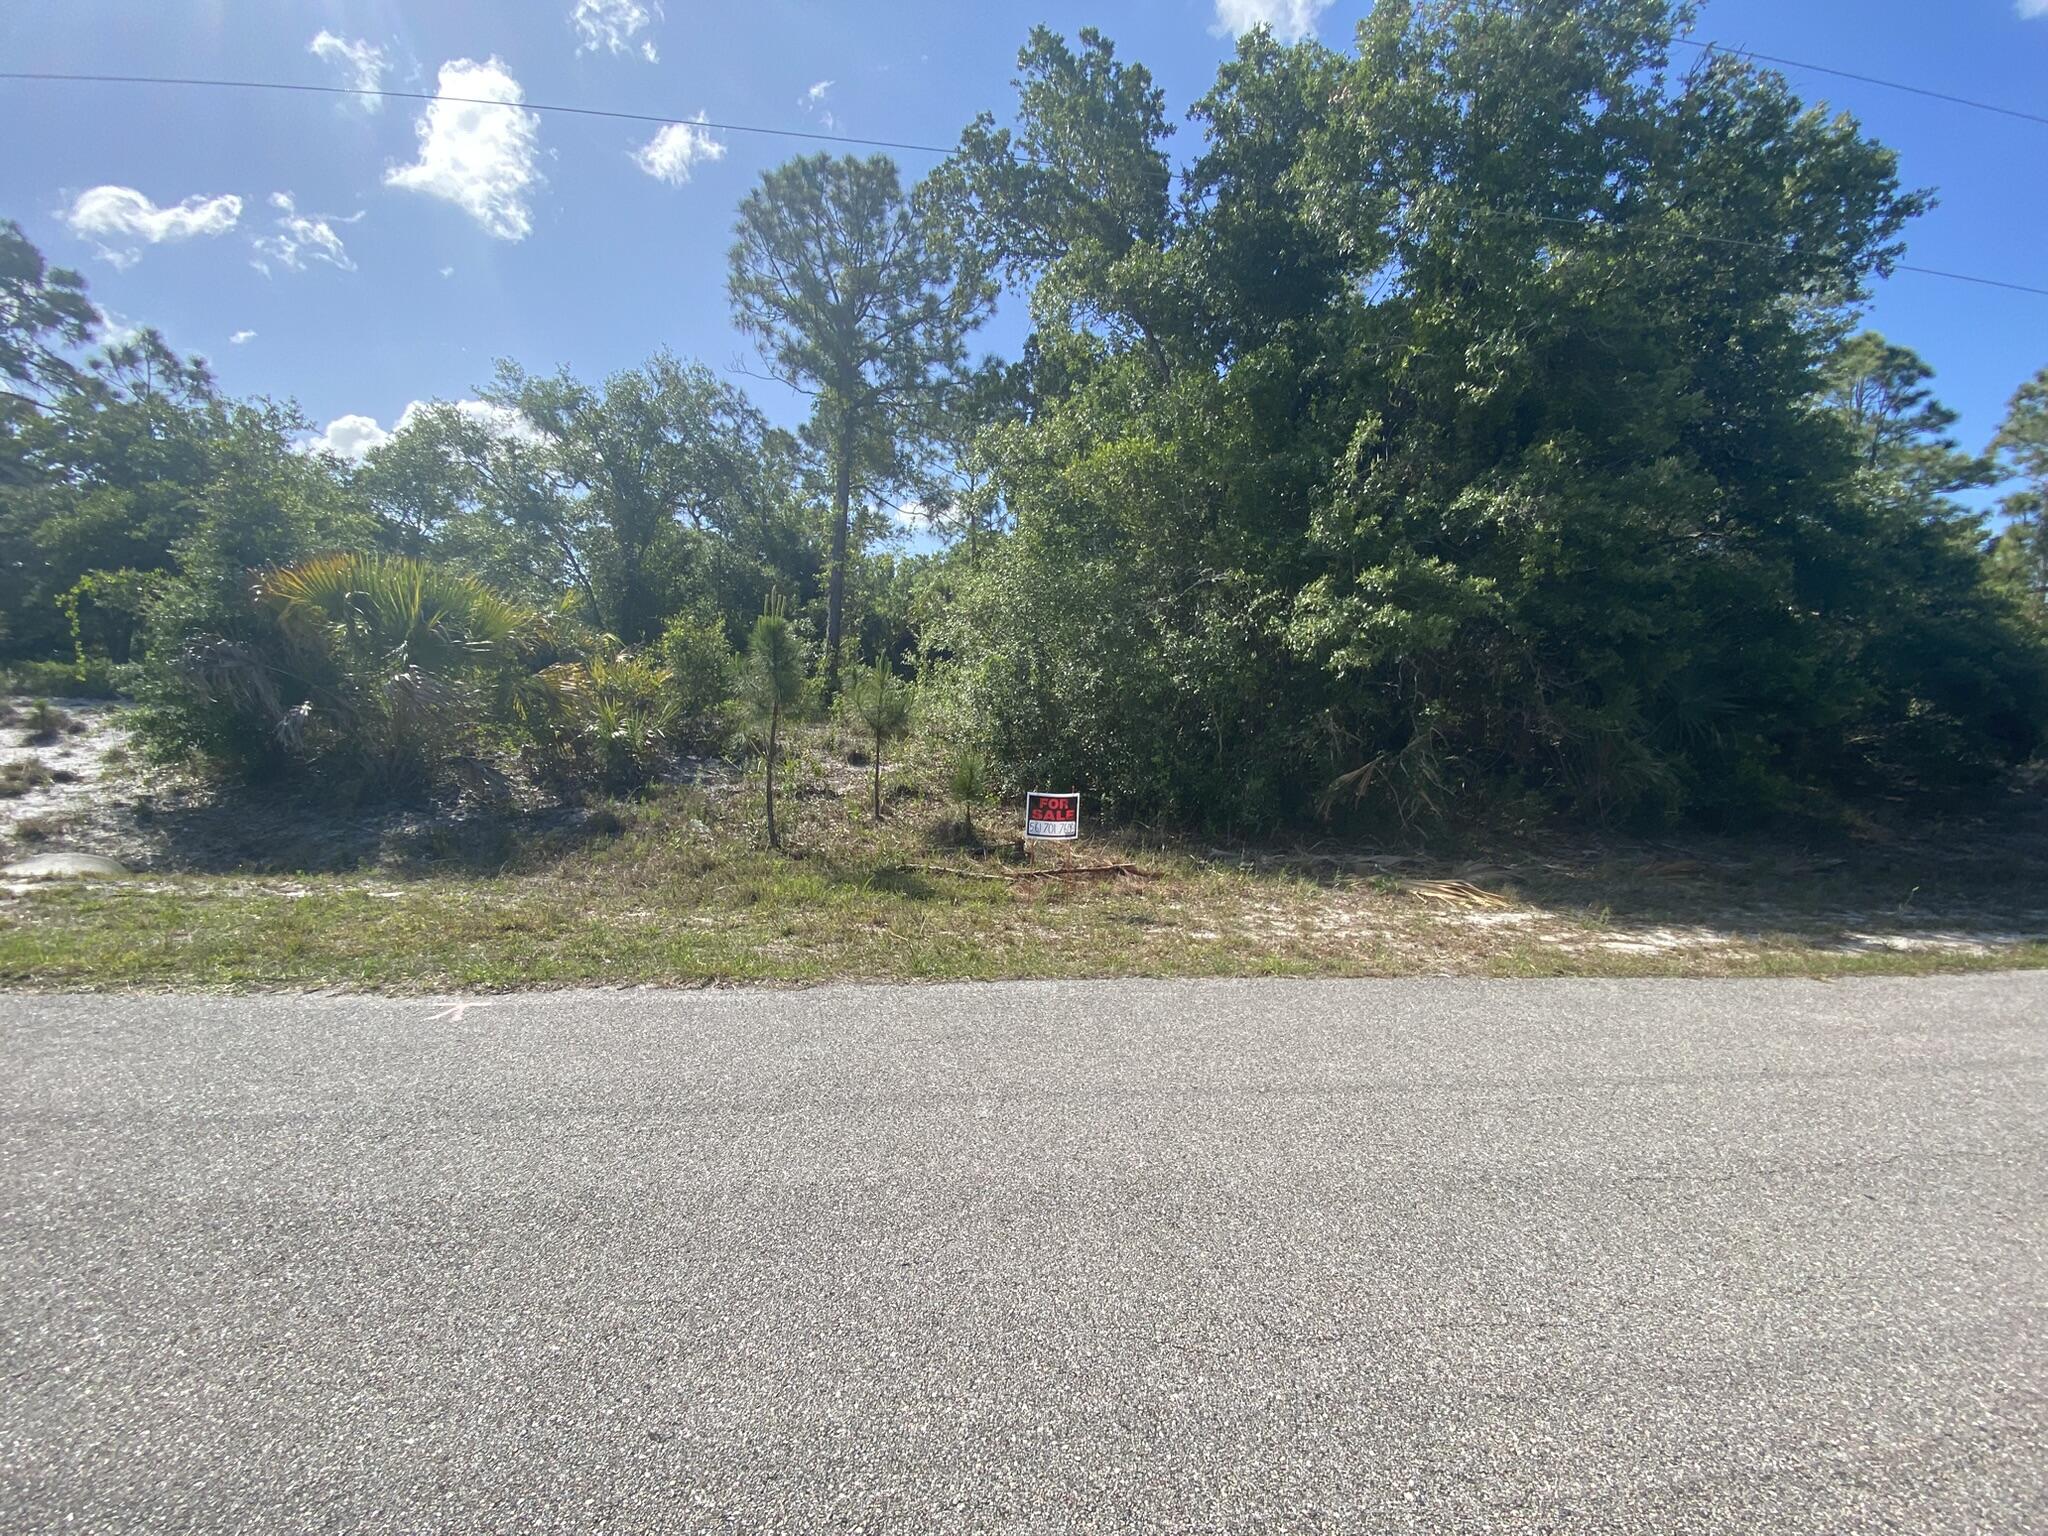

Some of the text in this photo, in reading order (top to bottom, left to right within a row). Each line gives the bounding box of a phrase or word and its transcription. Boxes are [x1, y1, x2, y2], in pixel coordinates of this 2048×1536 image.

[1039, 798, 1069, 809] FOR
[1032, 809, 1075, 820] SALE
[1029, 822, 1042, 833] 561
[1043, 823, 1056, 834] 701
